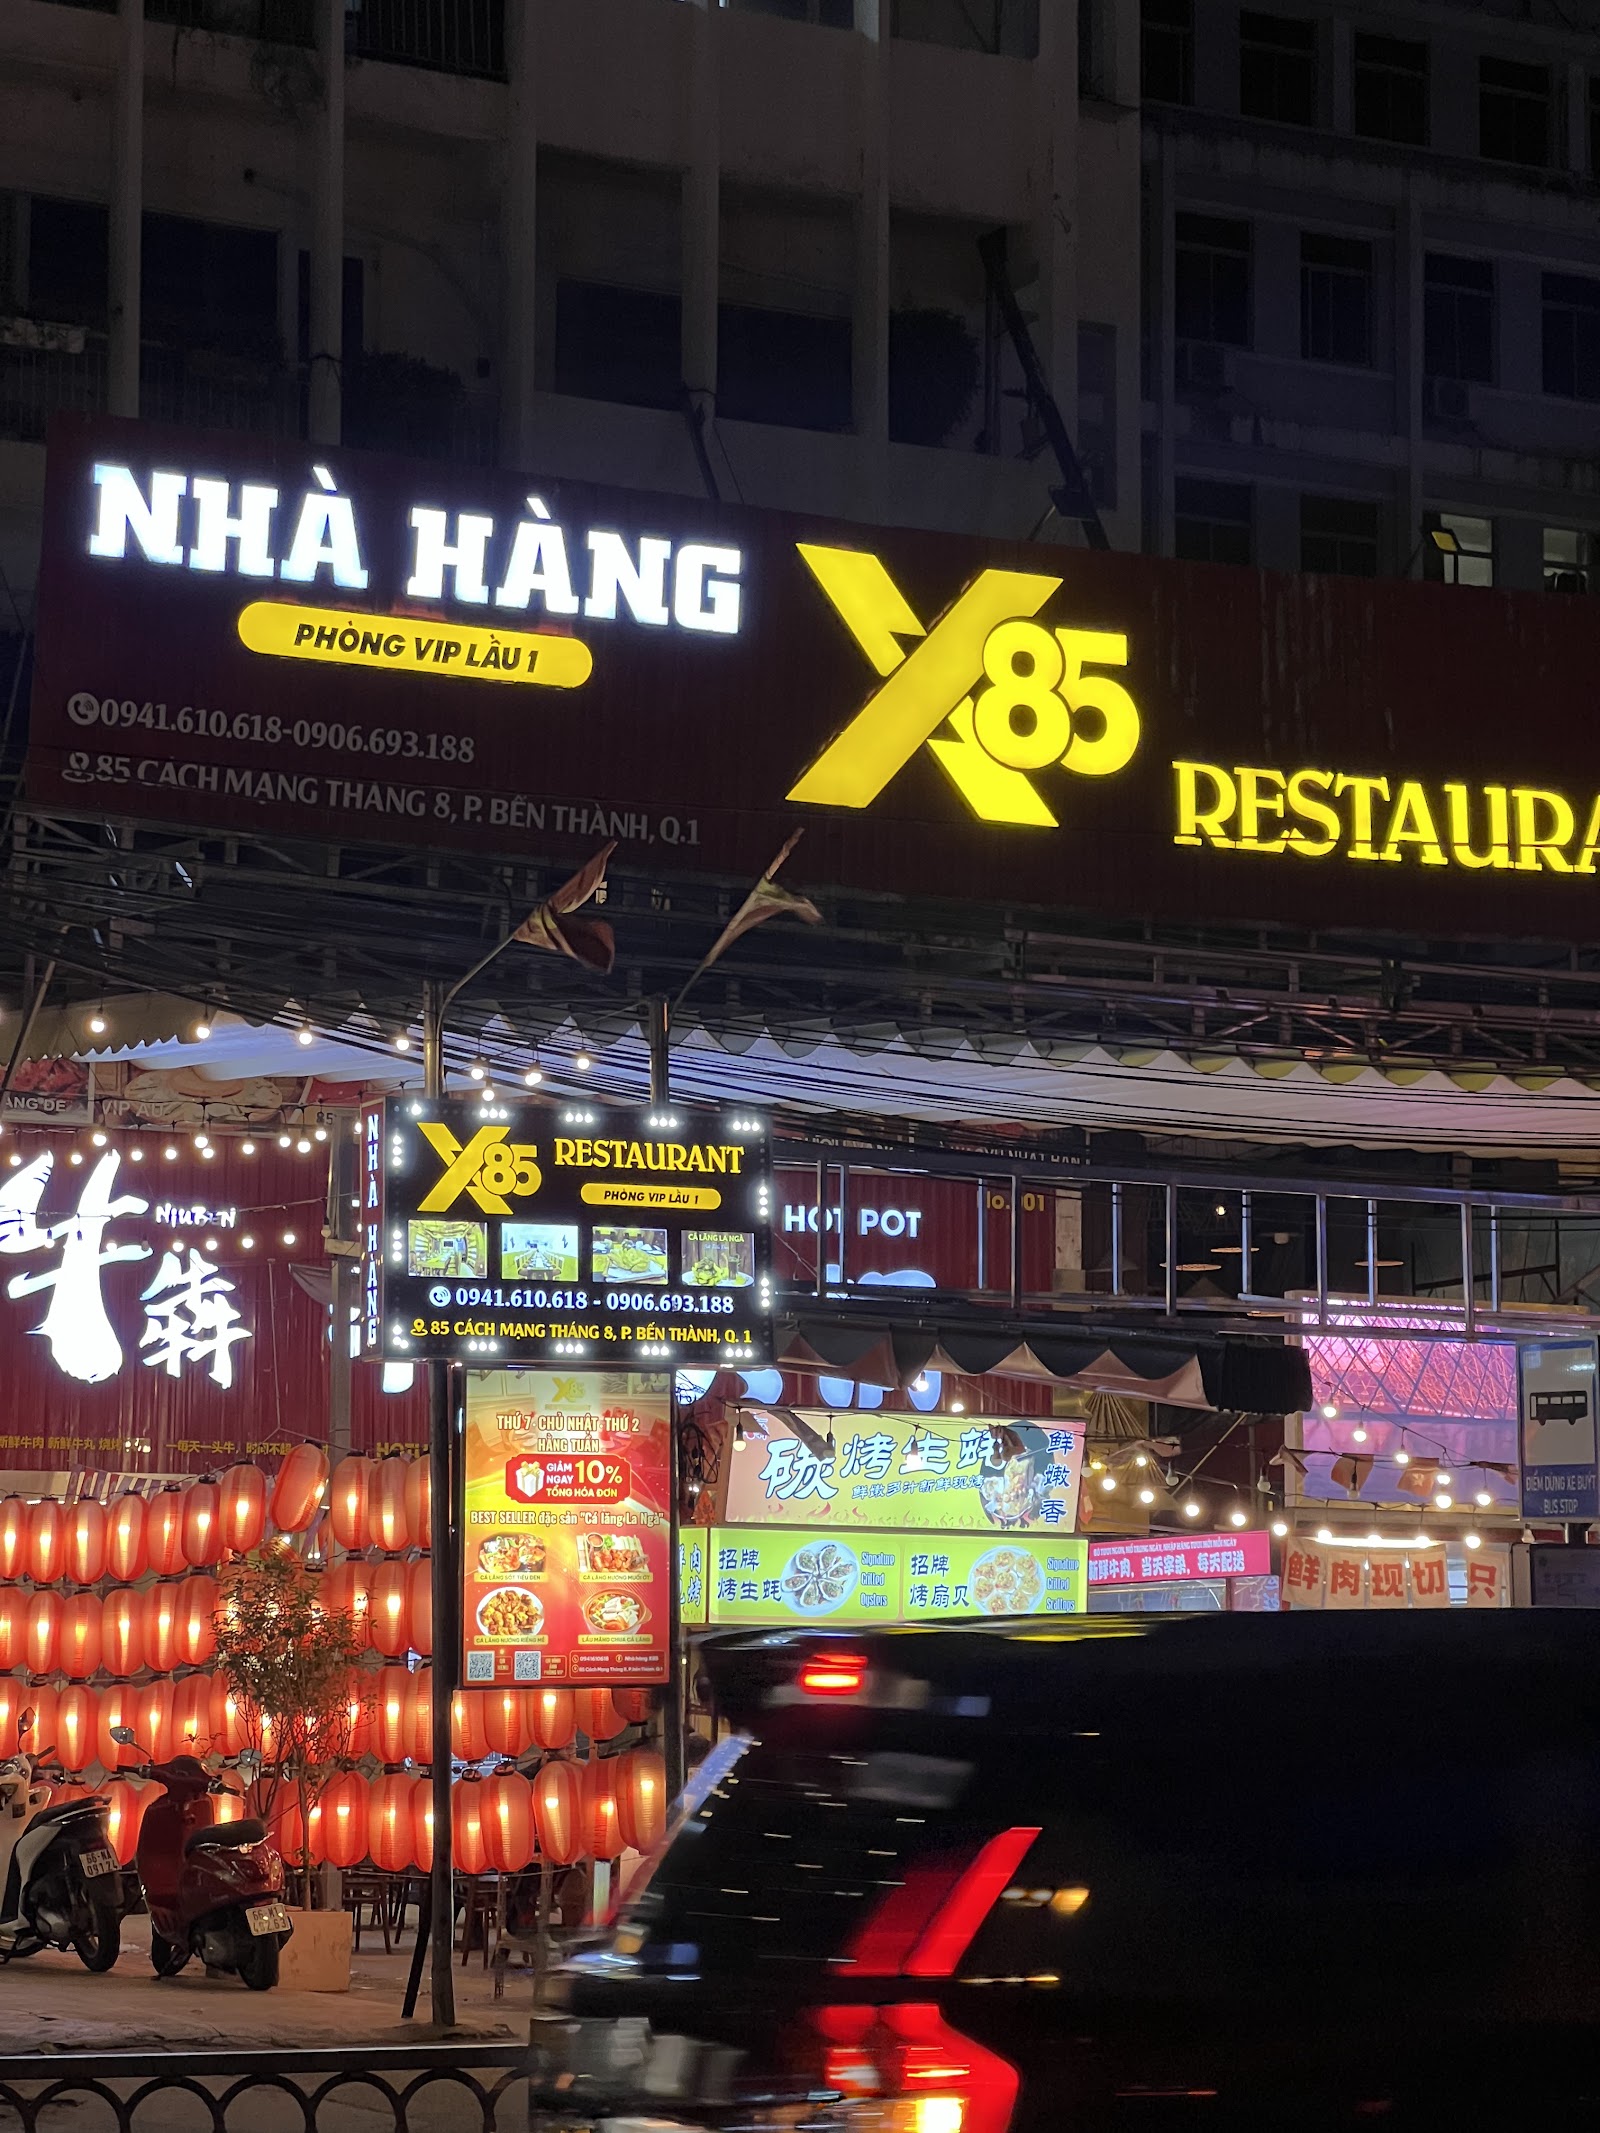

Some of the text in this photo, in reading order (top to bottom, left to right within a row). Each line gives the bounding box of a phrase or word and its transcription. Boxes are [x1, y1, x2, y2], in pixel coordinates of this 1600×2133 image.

[89, 464, 744, 635] NHÀ HÀNG
[294, 619, 540, 674] PHÒNG VIP LẦU 1
[785, 542, 1141, 828] X85
[99, 699, 478, 765] 0941.610.618-0906.693.188
[95, 755, 131, 784] 85
[225, 768, 317, 805] MẠNG
[433, 791, 457, 824] 8,
[463, 795, 483, 823] P.
[489, 793, 546, 831] BẾN
[552, 804, 656, 845] THÀNH,
[659, 815, 702, 847] Q.1
[416, 1121, 543, 1215] X85
[554, 1137, 745, 1174] RESTAURANT
[603, 1187, 645, 1203] PHÒNG
[647, 1192, 667, 1204] VIP
[667, 1191, 691, 1205] LẦU
[366, 1113, 380, 1346] NHÀ HÀNG
[860, 1207, 922, 1238] POT
[455, 1287, 588, 1311] 0941.610.618
[606, 1294, 734, 1315] 0906.693.188
[430, 1317, 753, 1345] 85 CÁCH MẠNG THÁNG 8, P. BẾN THÀNH, Q. 1
[496, 1411, 640, 1437] THỨ 7 CHỦ NHẬT THỨ 2
[546, 1459, 623, 1485] GIẢM 10%
[546, 1475, 574, 1485] NGAY
[1038, 1431, 1076, 1526] 鲜嫩香
[1566, 1474, 1577, 1491] XE
[546, 1485, 618, 1498] TỔNG HÓA ĐƠN
[1543, 1498, 1579, 1515] BUS STOP
[470, 1511, 664, 1529] BEST SELLER đặc sản "Cá lăng La Ngà"
[719, 1548, 760, 1572] 招牌
[861, 1552, 896, 1567] Signature
[911, 1554, 950, 1578] 招牌
[1046, 1556, 1080, 1571] Signature
[717, 1577, 783, 1602] 烤生蚝
[860, 1572, 885, 1586] Grilled
[1046, 1577, 1069, 1591] Grilled
[860, 1592, 888, 1608] Oysters
[909, 1583, 970, 1608] 烤扇贝
[1046, 1597, 1075, 1613] Scallops
